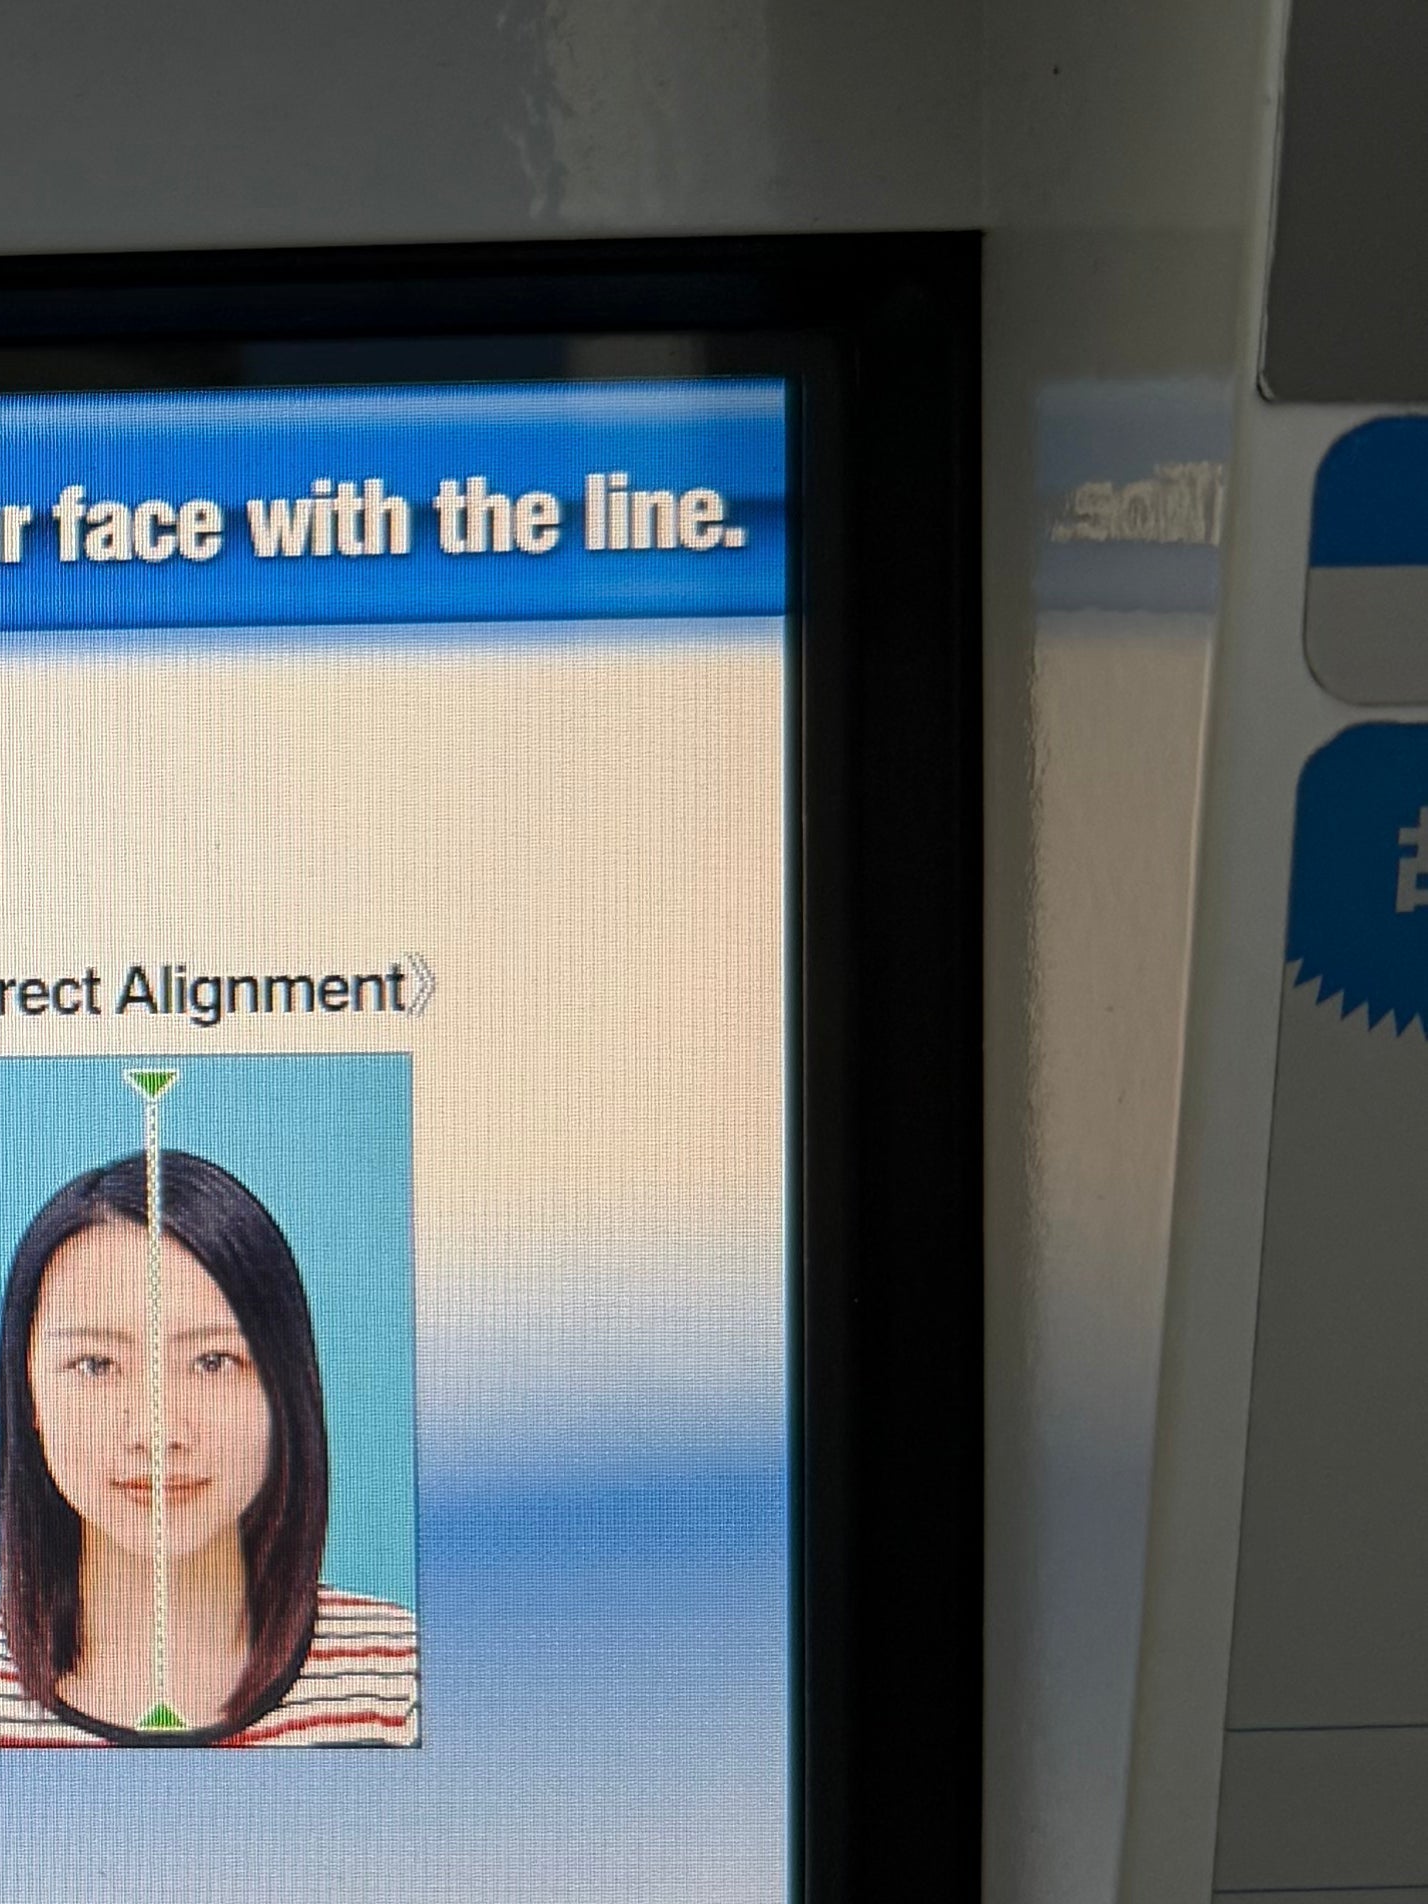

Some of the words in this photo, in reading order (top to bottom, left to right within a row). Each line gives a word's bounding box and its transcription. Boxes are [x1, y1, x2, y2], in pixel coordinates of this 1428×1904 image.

[52, 485, 223, 563] face
[246, 478, 410, 558] with
[434, 476, 560, 555] the
[586, 471, 746, 551] line.
